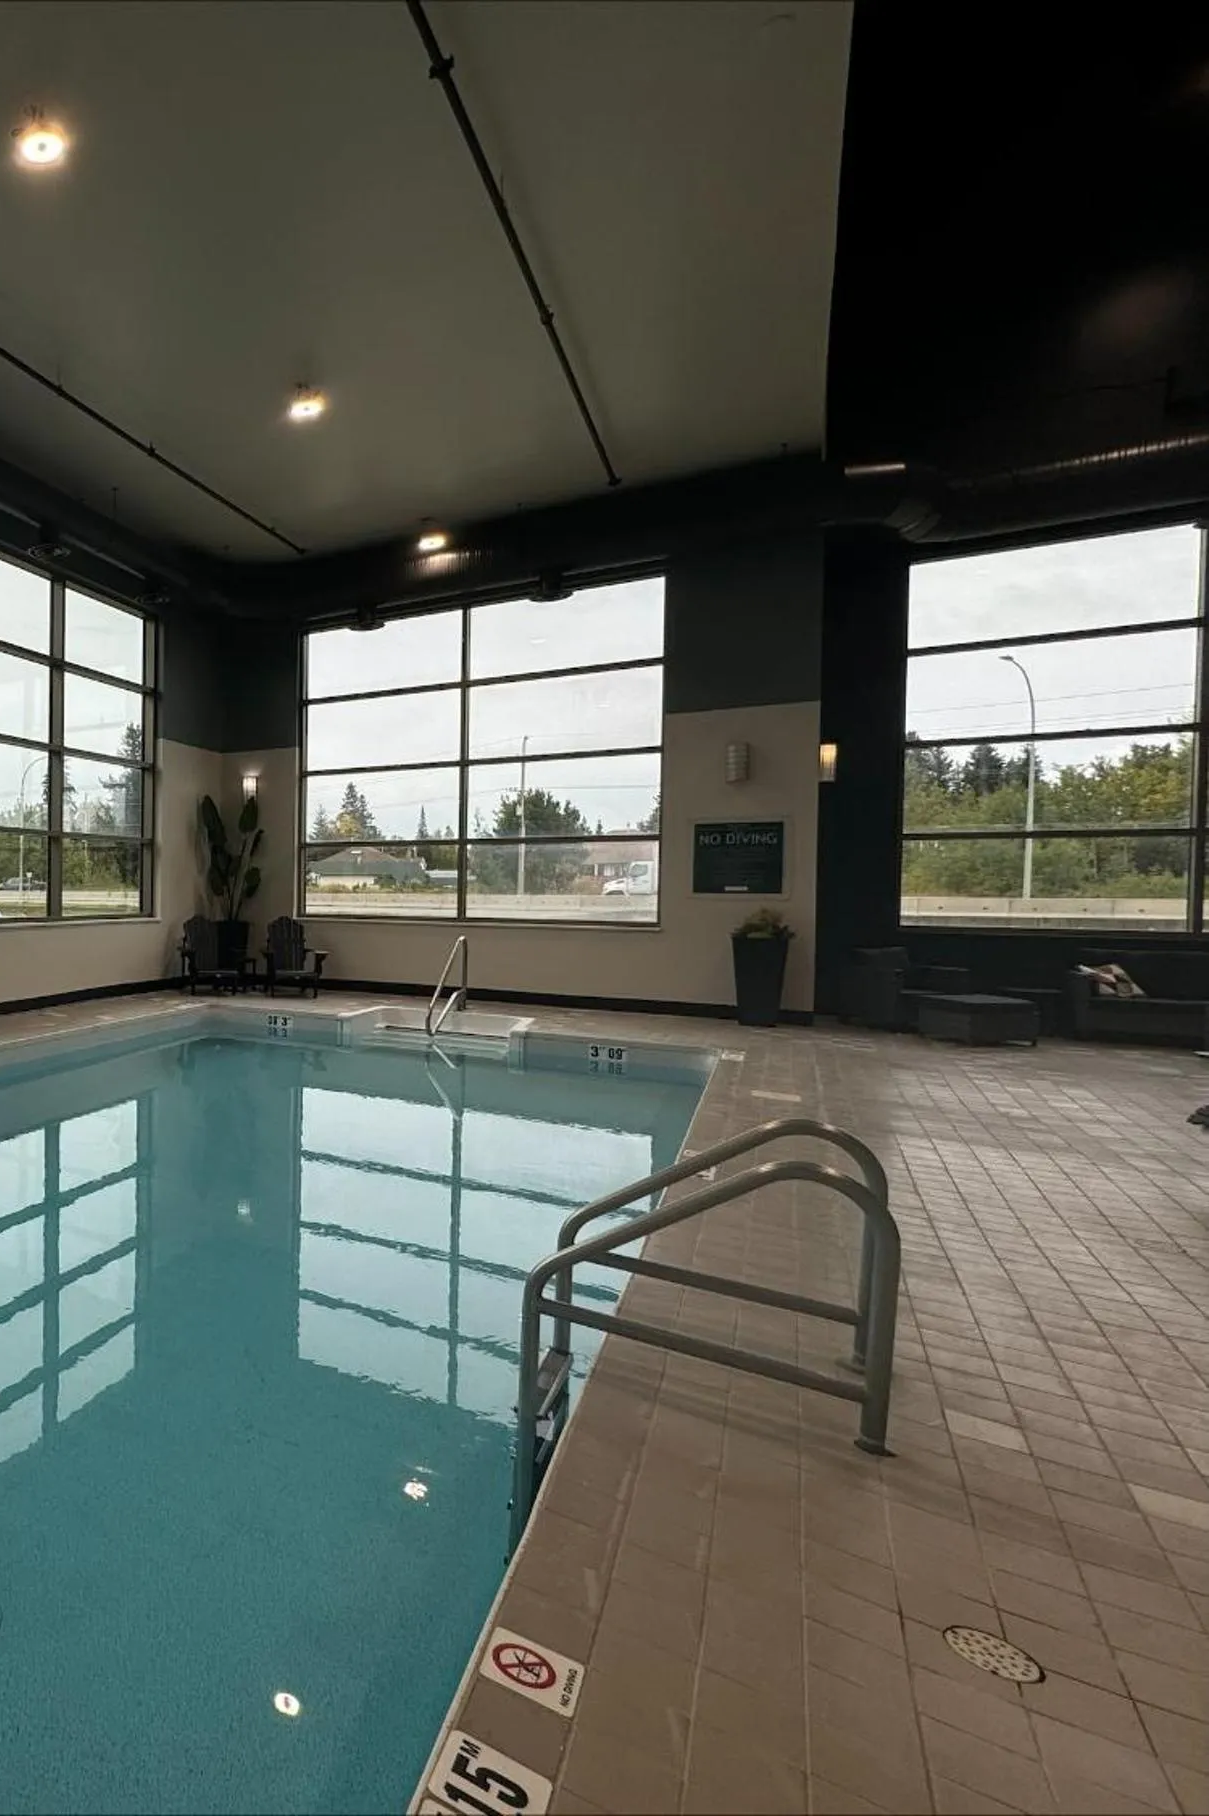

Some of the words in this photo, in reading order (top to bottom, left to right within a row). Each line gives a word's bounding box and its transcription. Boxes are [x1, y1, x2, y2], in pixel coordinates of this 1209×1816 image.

[699, 833, 721, 845] NO
[726, 832, 777, 845] DIVING
[563, 1668, 578, 1695] DIVING
[559, 1693, 571, 1708] NO
